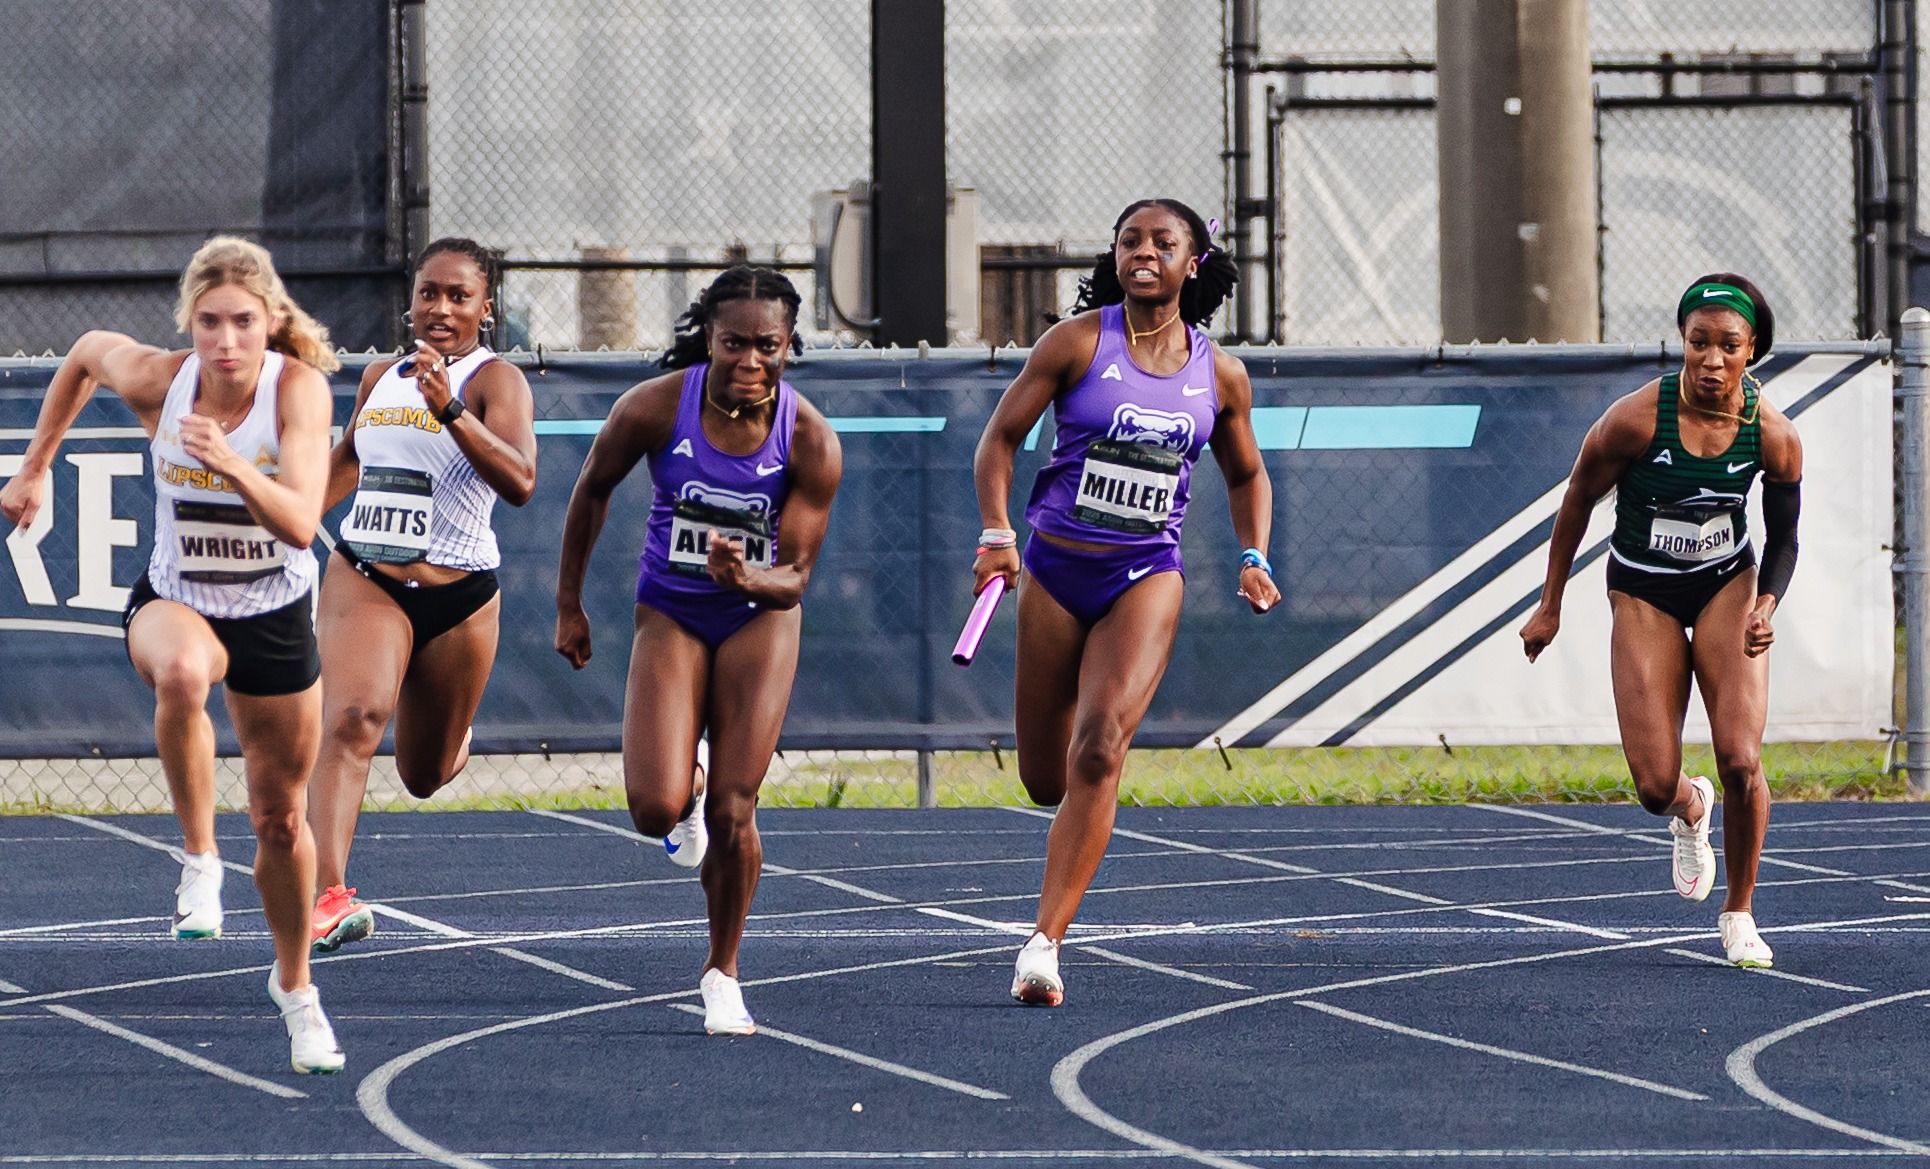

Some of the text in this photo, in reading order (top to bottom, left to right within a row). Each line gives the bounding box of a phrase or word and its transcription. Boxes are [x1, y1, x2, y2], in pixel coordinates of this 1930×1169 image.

[1083, 472, 1169, 512] MILLER
[352, 505, 427, 536] WATTS
[180, 535, 278, 559] WRIGHT
[675, 529, 765, 561] ALN
[1654, 528, 1730, 553] THOMPSON
